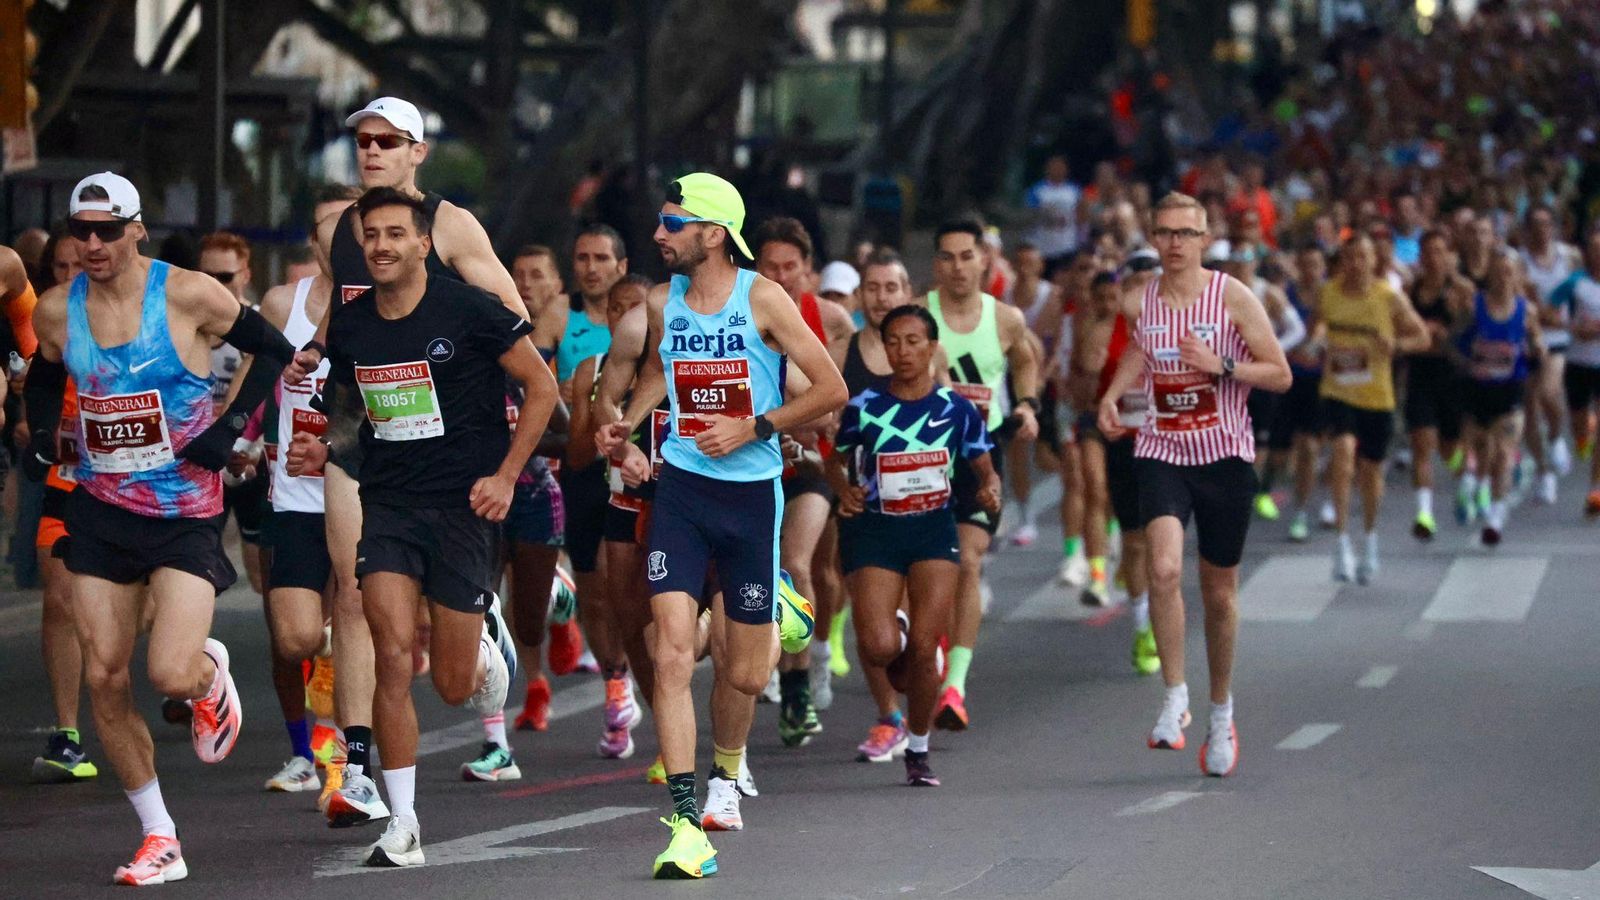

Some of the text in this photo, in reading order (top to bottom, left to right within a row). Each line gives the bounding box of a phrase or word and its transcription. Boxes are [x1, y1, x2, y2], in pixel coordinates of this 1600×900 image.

[671, 328, 747, 358] nerja
[372, 366, 424, 380] GENERALI
[690, 363, 743, 375] GENERALI
[374, 391, 417, 407] 18057
[691, 388, 727, 403] 6251
[94, 396, 153, 412] GENERALI
[96, 423, 146, 439] 17212
